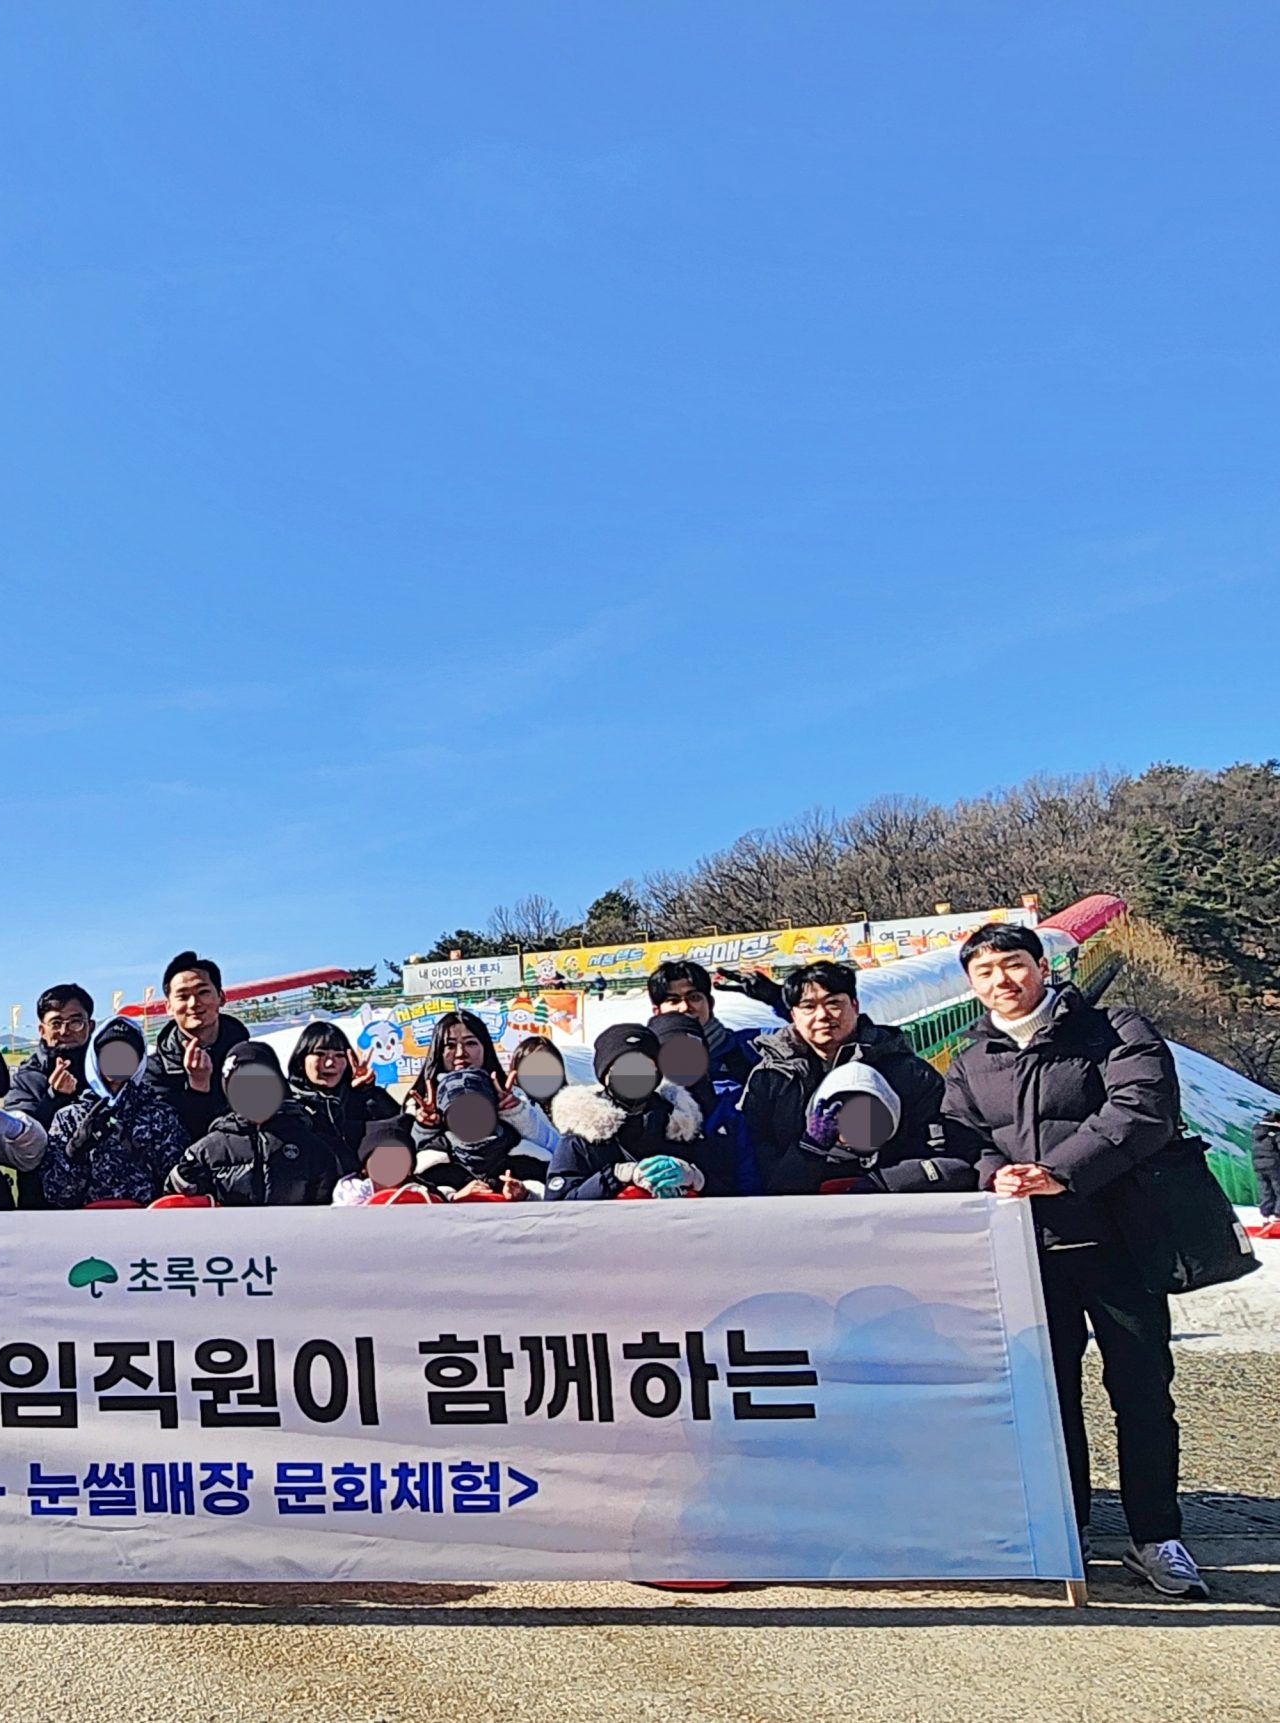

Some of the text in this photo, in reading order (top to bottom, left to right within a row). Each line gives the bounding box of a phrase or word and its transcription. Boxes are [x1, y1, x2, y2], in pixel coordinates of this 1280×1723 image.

[418, 961, 504, 980] 내 아이의 첫 투자,
[429, 976, 492, 990] KODEX ETF
[127, 1256, 278, 1298] 초록우산
[419, 1330, 819, 1425] 함께하는
[27, 1462, 254, 1518] 눈썰매장
[274, 1461, 539, 1515] 문화체험>
